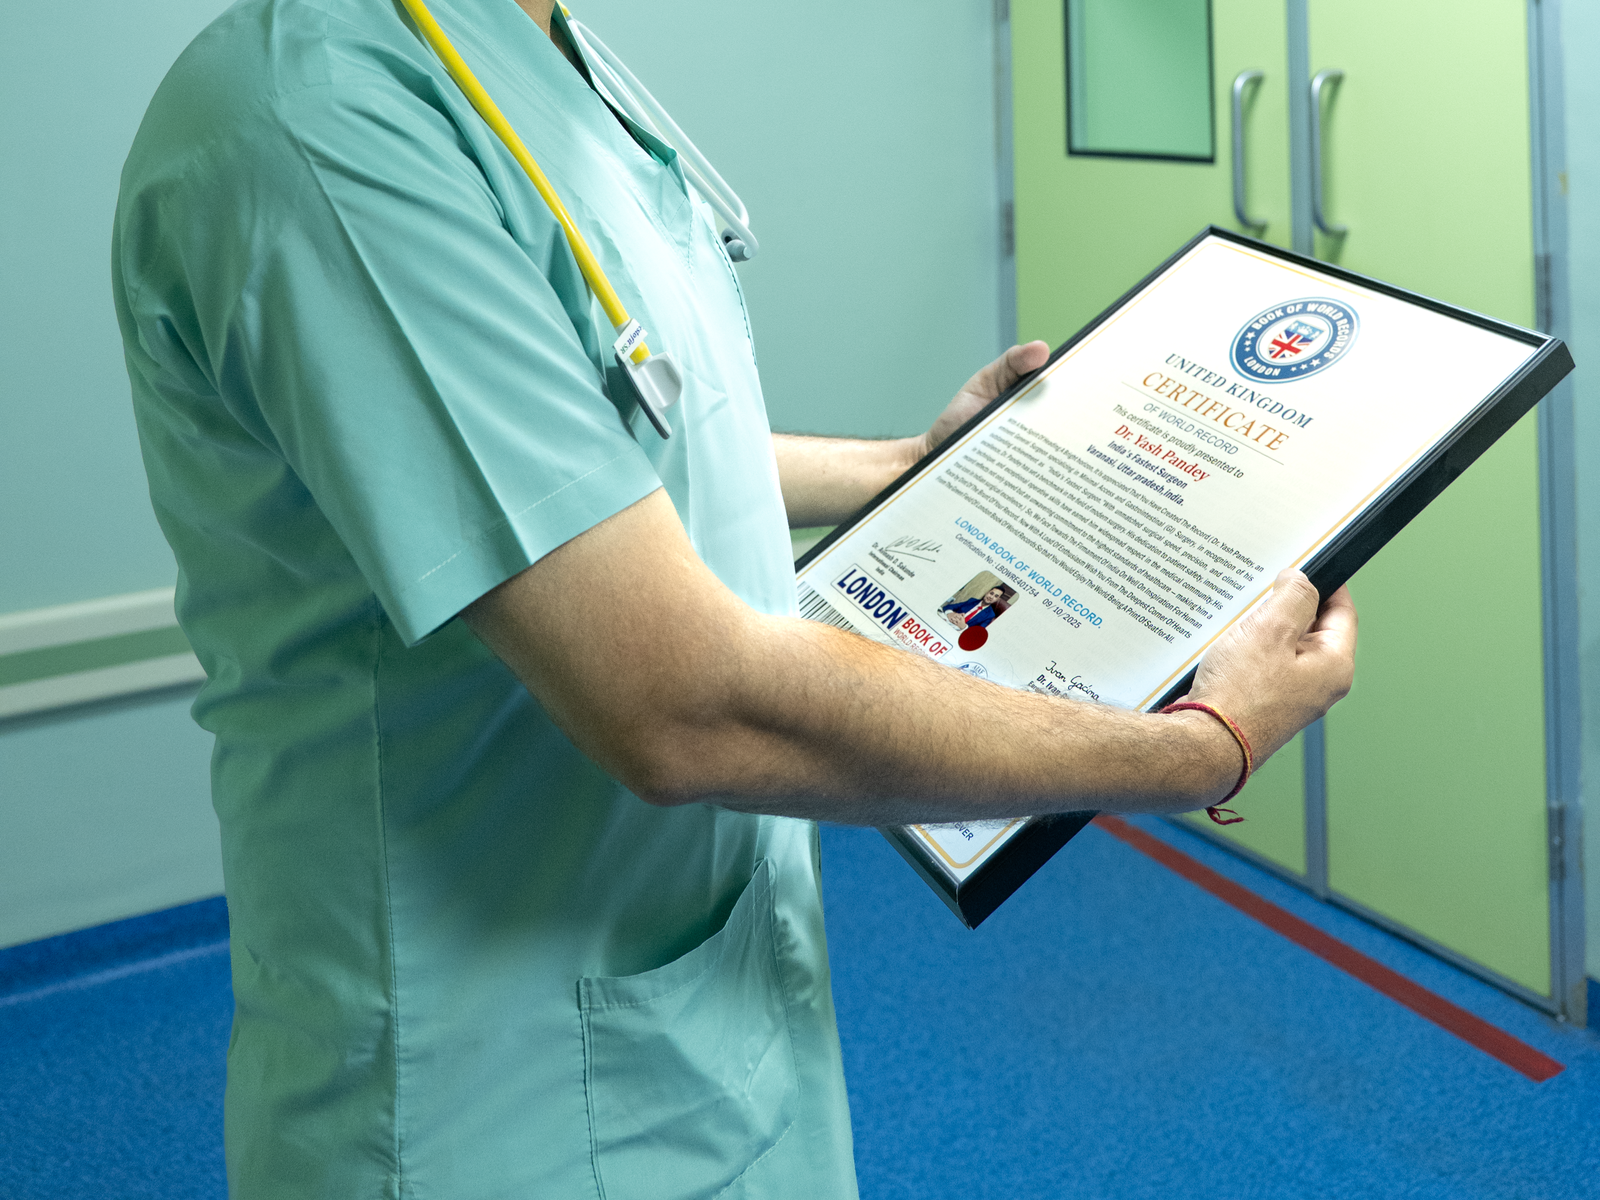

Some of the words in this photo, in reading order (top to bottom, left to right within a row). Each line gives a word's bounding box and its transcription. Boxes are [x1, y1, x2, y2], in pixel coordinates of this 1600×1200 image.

[1251, 308, 1285, 331] BOOK
[1285, 303, 1304, 315] OF
[1306, 302, 1344, 321] WORLD
[1323, 317, 1351, 360] RECORDS
[1243, 356, 1281, 376] LONDON
[1165, 353, 1227, 388] UNITED
[1226, 383, 1313, 428] KINGDOM
[1143, 373, 1289, 451] CERTIFICATE
[1143, 402, 1161, 413] OF
[1158, 410, 1195, 433] WORLD
[1193, 428, 1239, 455] RECORD
[1086, 444, 1118, 468] Varanasi,
[1116, 462, 1137, 477] Uttar
[1113, 404, 1129, 417] This
[1126, 413, 1163, 436] certificate
[1160, 430, 1170, 440] is
[1166, 435, 1198, 455] proudly
[1193, 450, 1237, 474] presented
[1233, 468, 1245, 479] to
[1114, 424, 1134, 441] Dr.
[1134, 434, 1163, 457] Yash
[1161, 450, 1210, 482] Pandey
[1107, 440, 1133, 459] India's
[1131, 453, 1160, 473] Fastest
[1156, 467, 1188, 489] Surgeon
[954, 517, 992, 545] LONDON
[988, 541, 1017, 564] BOOK
[1014, 560, 1030, 572] OF
[1027, 569, 1063, 597] WORLD
[1060, 594, 1103, 629] RECORD.
[1180, 550, 1208, 571] precision,
[1208, 567, 1224, 578] and
[1221, 575, 1246, 591] clinical
[1196, 544, 1205, 552] in
[1203, 549, 1237, 571] recognition
[1235, 568, 1246, 576] of
[1242, 572, 1255, 582] his
[1210, 537, 1221, 547] Dr.
[1219, 542, 1234, 555] Yash
[1232, 550, 1255, 568] Pandey,
[1254, 564, 1265, 573] an
[955, 533, 986, 559] Certification
[984, 555, 994, 565] No
[1042, 598, 1082, 629] 09/10/2025
[1159, 567, 1185, 584] medical
[1184, 568, 1204, 583] safety,
[1202, 578, 1234, 601] innovation
[837, 569, 907, 629] LONDON
[901, 617, 934, 646] BOOK
[928, 641, 948, 656] OF
[1126, 591, 1151, 611] Deepest
[1165, 618, 1176, 627] Of
[1171, 622, 1192, 639] Hearts
[1143, 587, 1174, 611] Inspiration
[1171, 605, 1184, 616] For
[1180, 611, 1203, 629] Human
[1175, 593, 1198, 611] making
[1195, 605, 1209, 617] him
[893, 628, 913, 646] WORLD
[1125, 607, 1141, 621] Print
[1137, 615, 1149, 624] Of
[1143, 620, 1160, 633] Seat
[1156, 628, 1167, 638] for
[1163, 633, 1175, 644] All.
[1036, 673, 1047, 686] Dr.
[1045, 681, 1062, 697] Ivan
[954, 821, 974, 841] EVER
